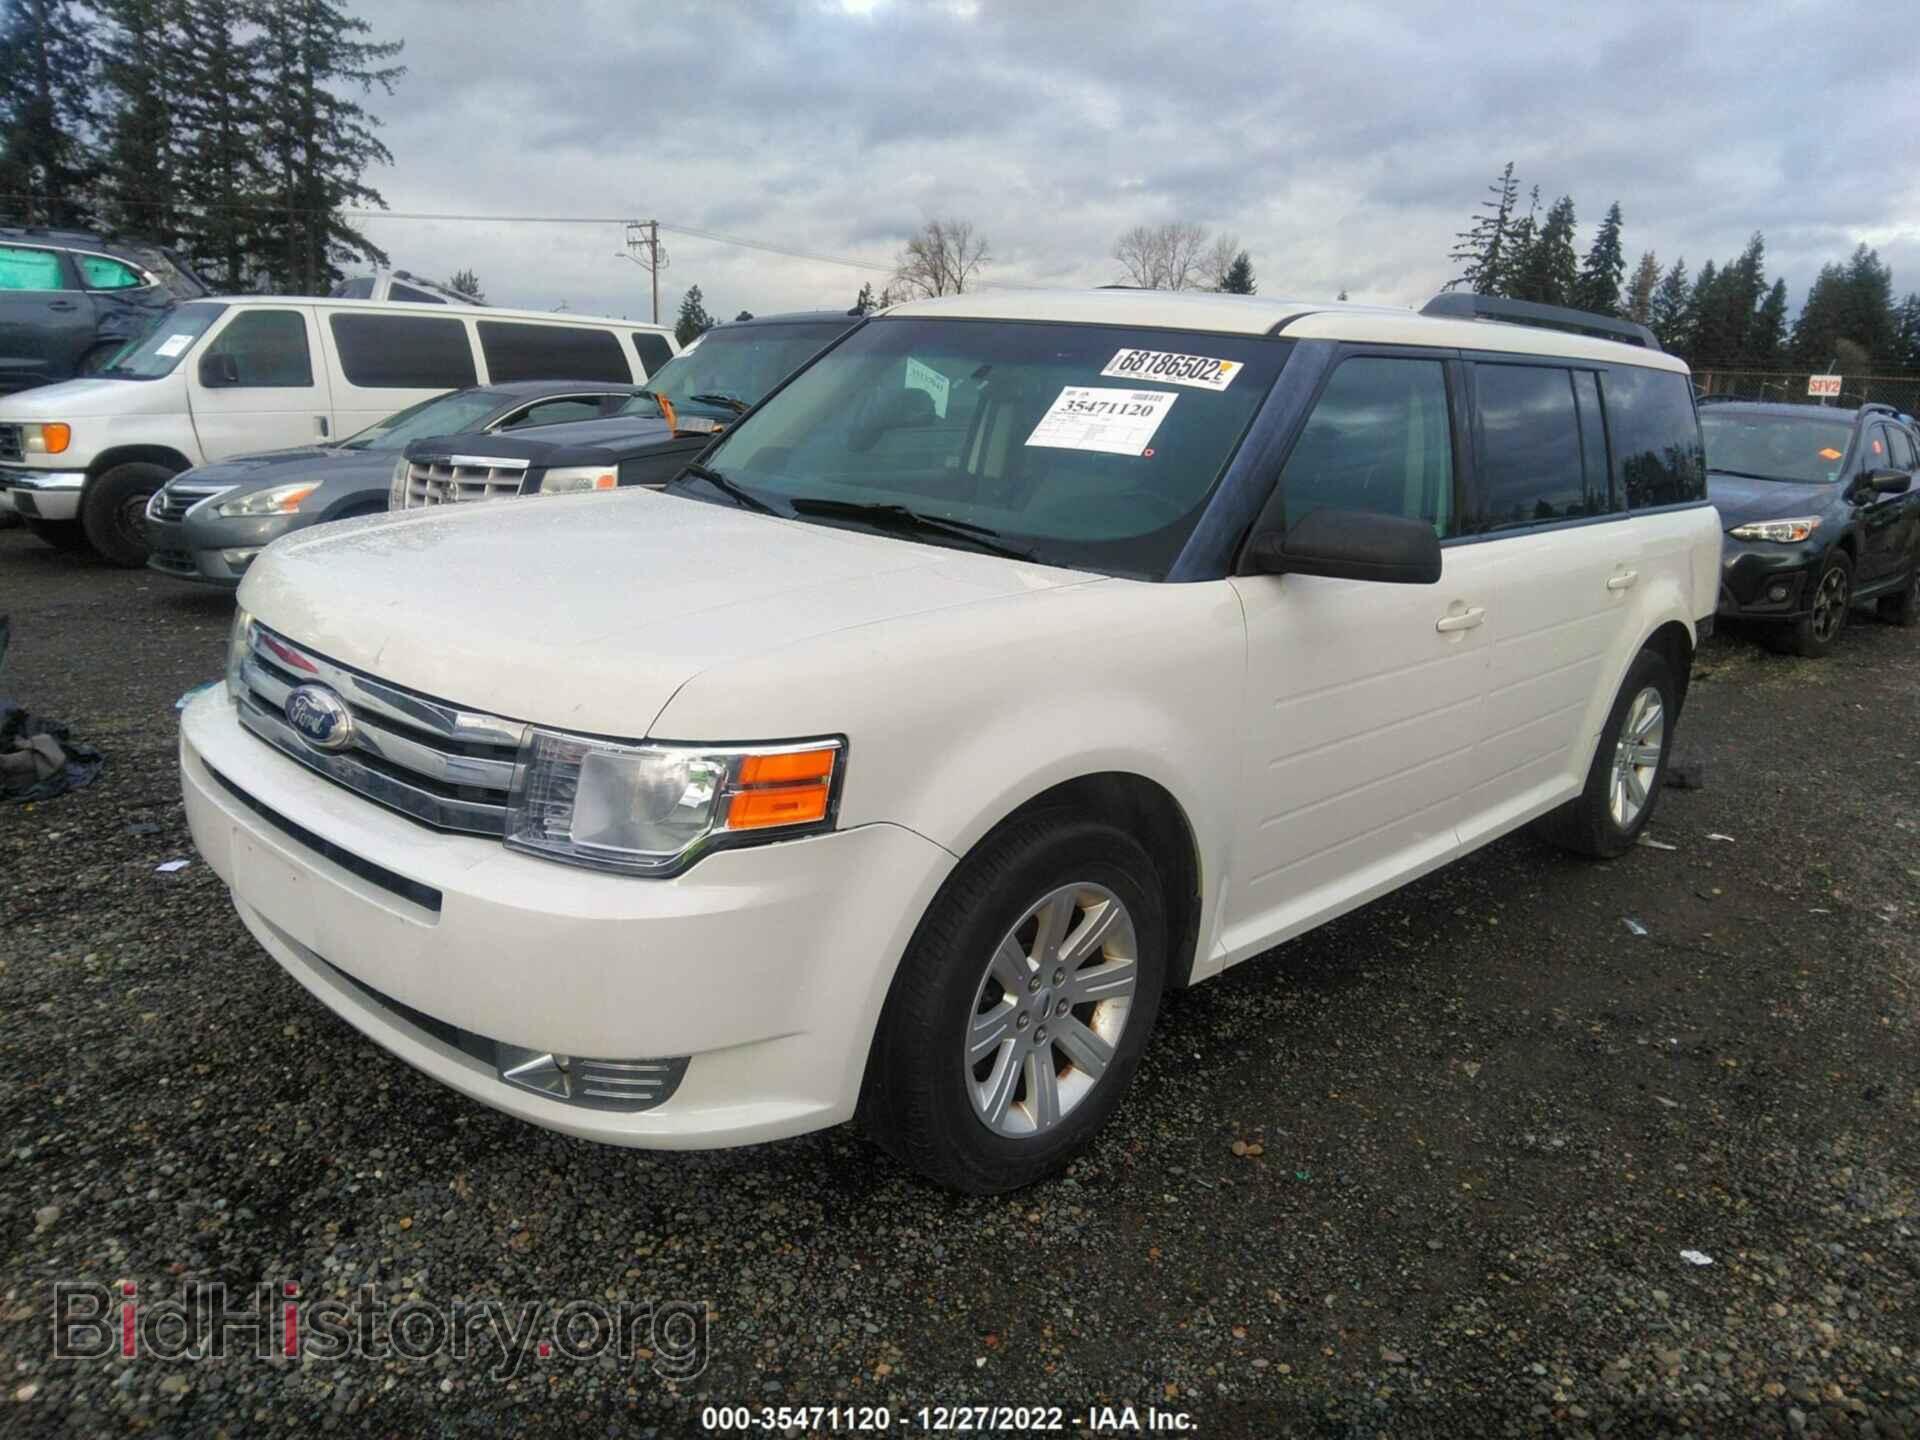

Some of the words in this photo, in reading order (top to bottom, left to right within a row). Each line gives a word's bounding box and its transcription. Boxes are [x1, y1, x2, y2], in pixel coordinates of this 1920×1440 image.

[1118, 350, 1221, 381] 68186502
[1061, 399, 1154, 417] 35471120
[290, 694, 328, 735] Ford
